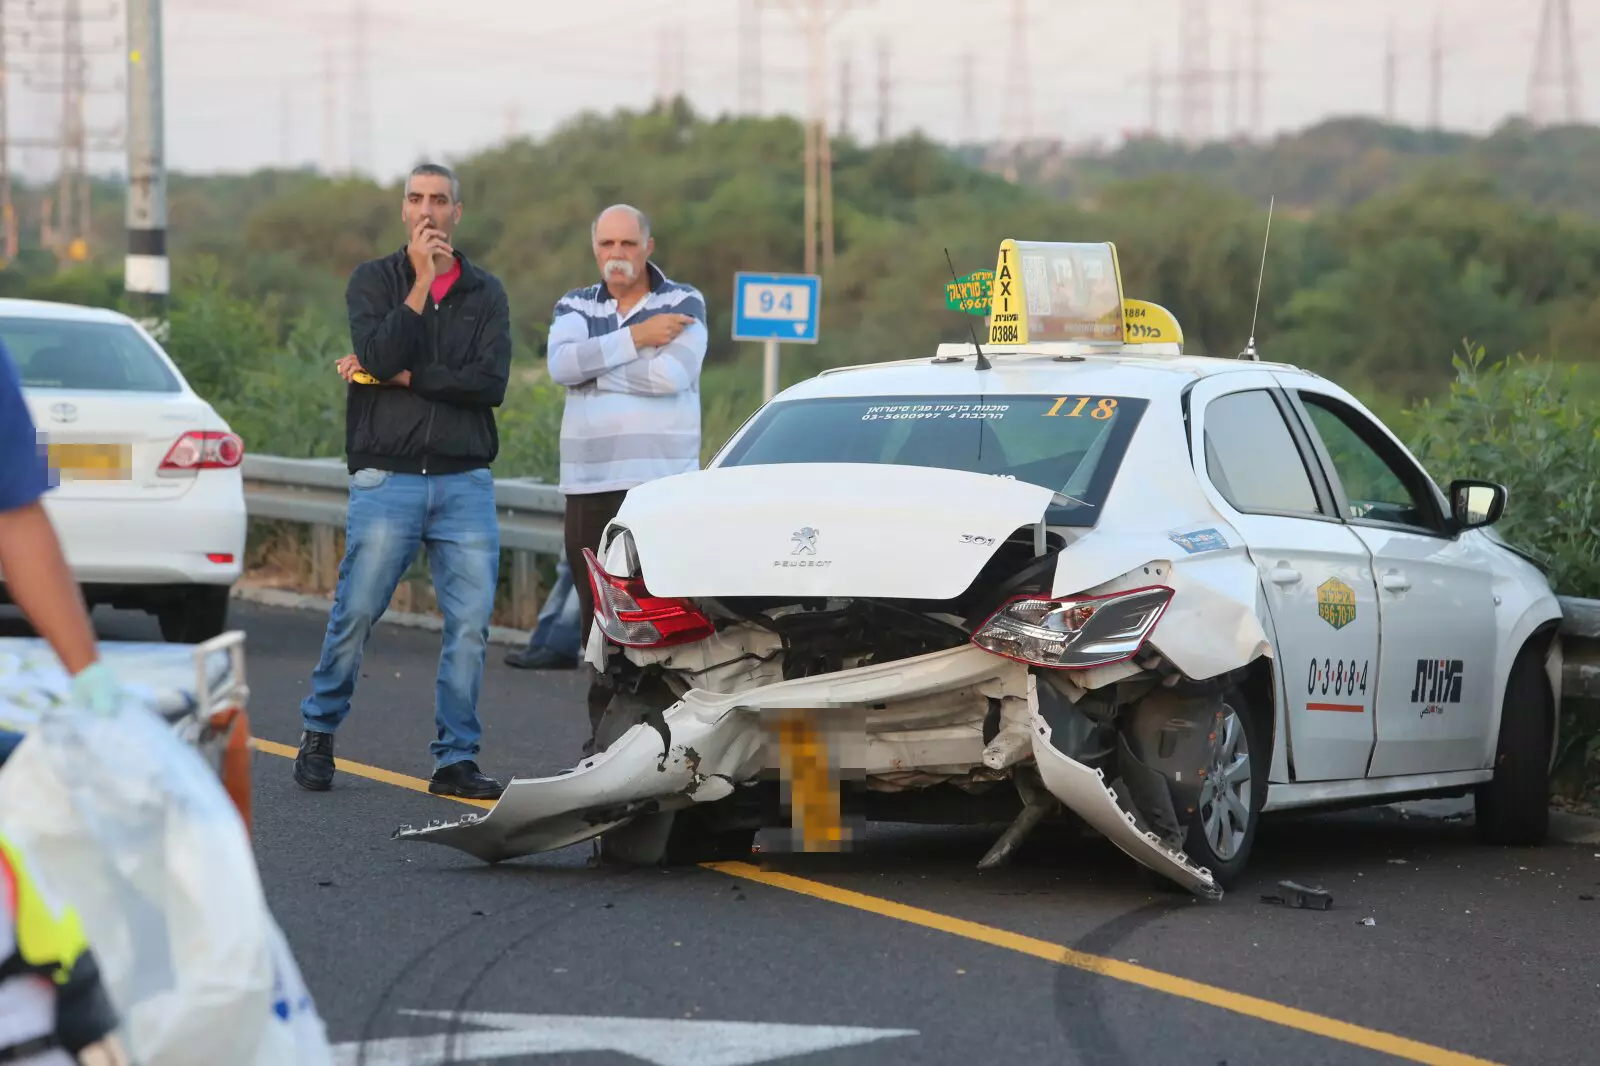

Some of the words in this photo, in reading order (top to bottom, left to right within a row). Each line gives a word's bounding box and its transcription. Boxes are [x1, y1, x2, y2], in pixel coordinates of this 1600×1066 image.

[1000, 249, 1012, 311] TAXI
[759, 289, 792, 313] 94
[994, 314, 1018, 322] מונית
[992, 325, 1018, 342] 03884
[1126, 322, 1161, 338] מוני
[866, 405, 910, 415] סיטרואן
[971, 404, 1010, 412] סוכנות
[1040, 397, 1118, 420] 118
[861, 412, 941, 421] 03-5600997
[960, 534, 995, 547] 301
[773, 560, 832, 568] PEUGEOT
[1411, 659, 1463, 703] מונית
